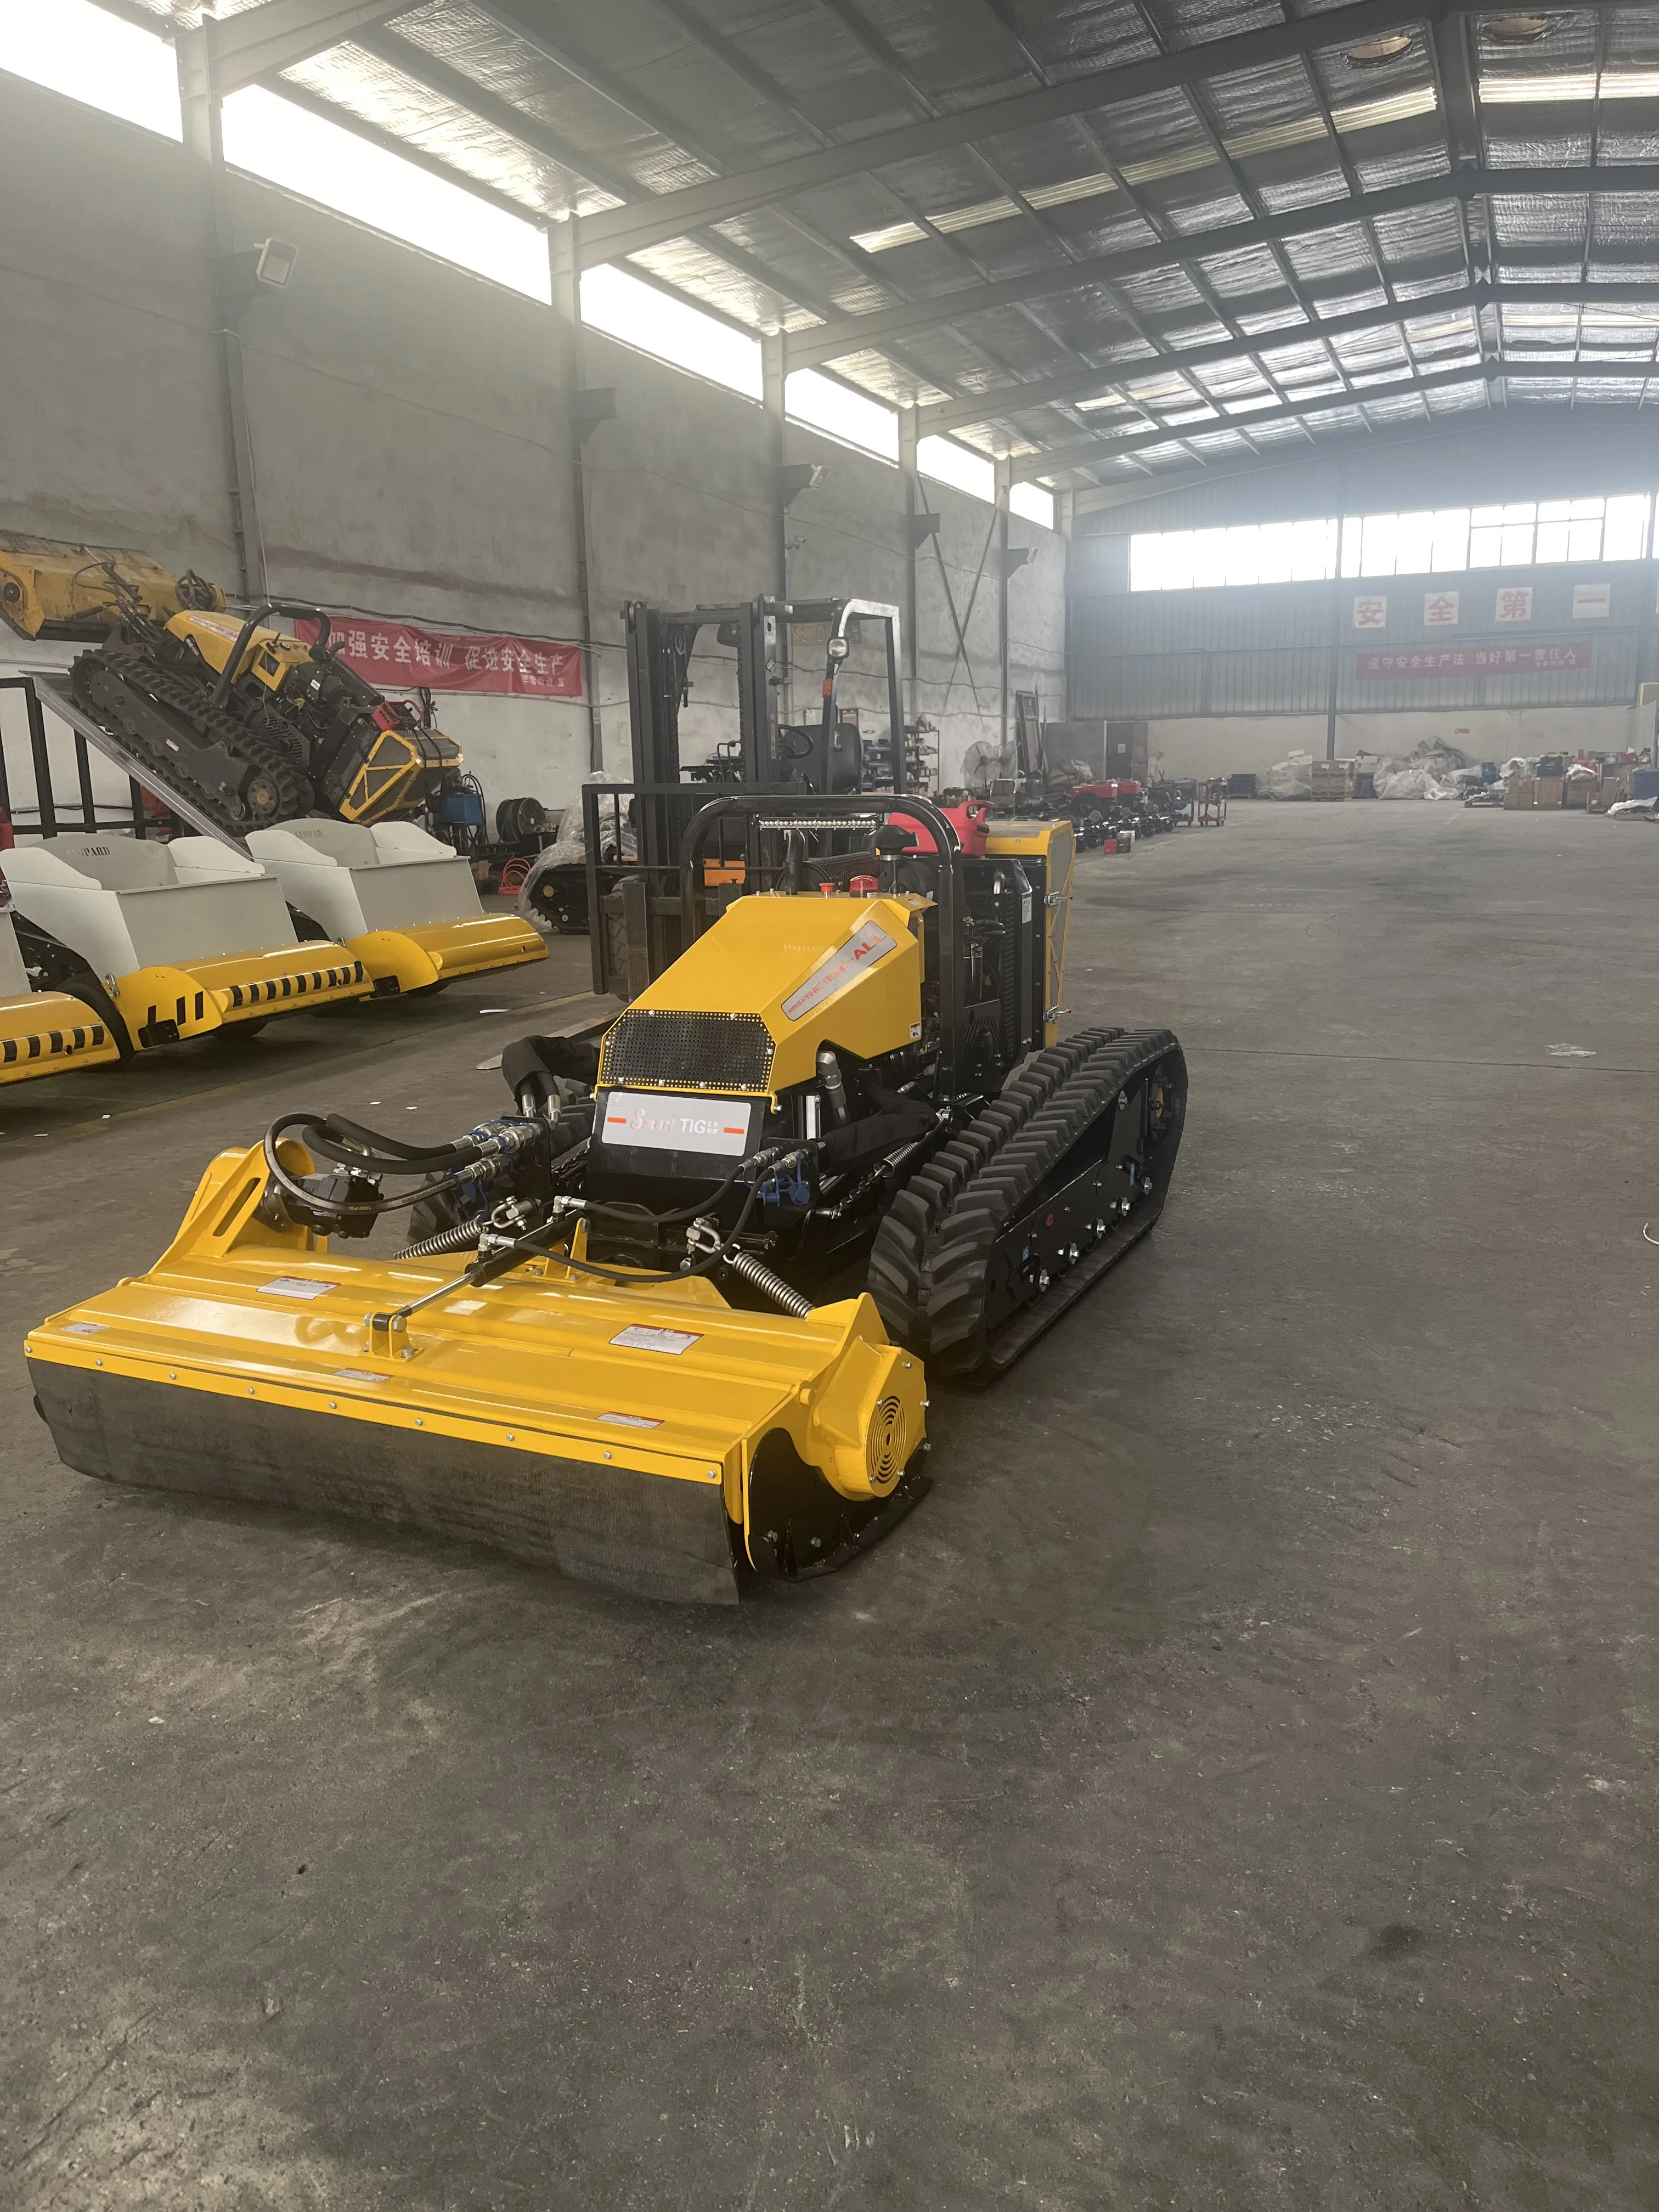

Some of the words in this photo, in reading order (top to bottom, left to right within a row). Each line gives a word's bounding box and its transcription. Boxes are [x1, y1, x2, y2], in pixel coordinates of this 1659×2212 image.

[1357, 591, 1606, 625] 安全第一
[1368, 652, 1465, 669] 遵守安全生产法
[1476, 647, 1576, 664] 当好第一责任人
